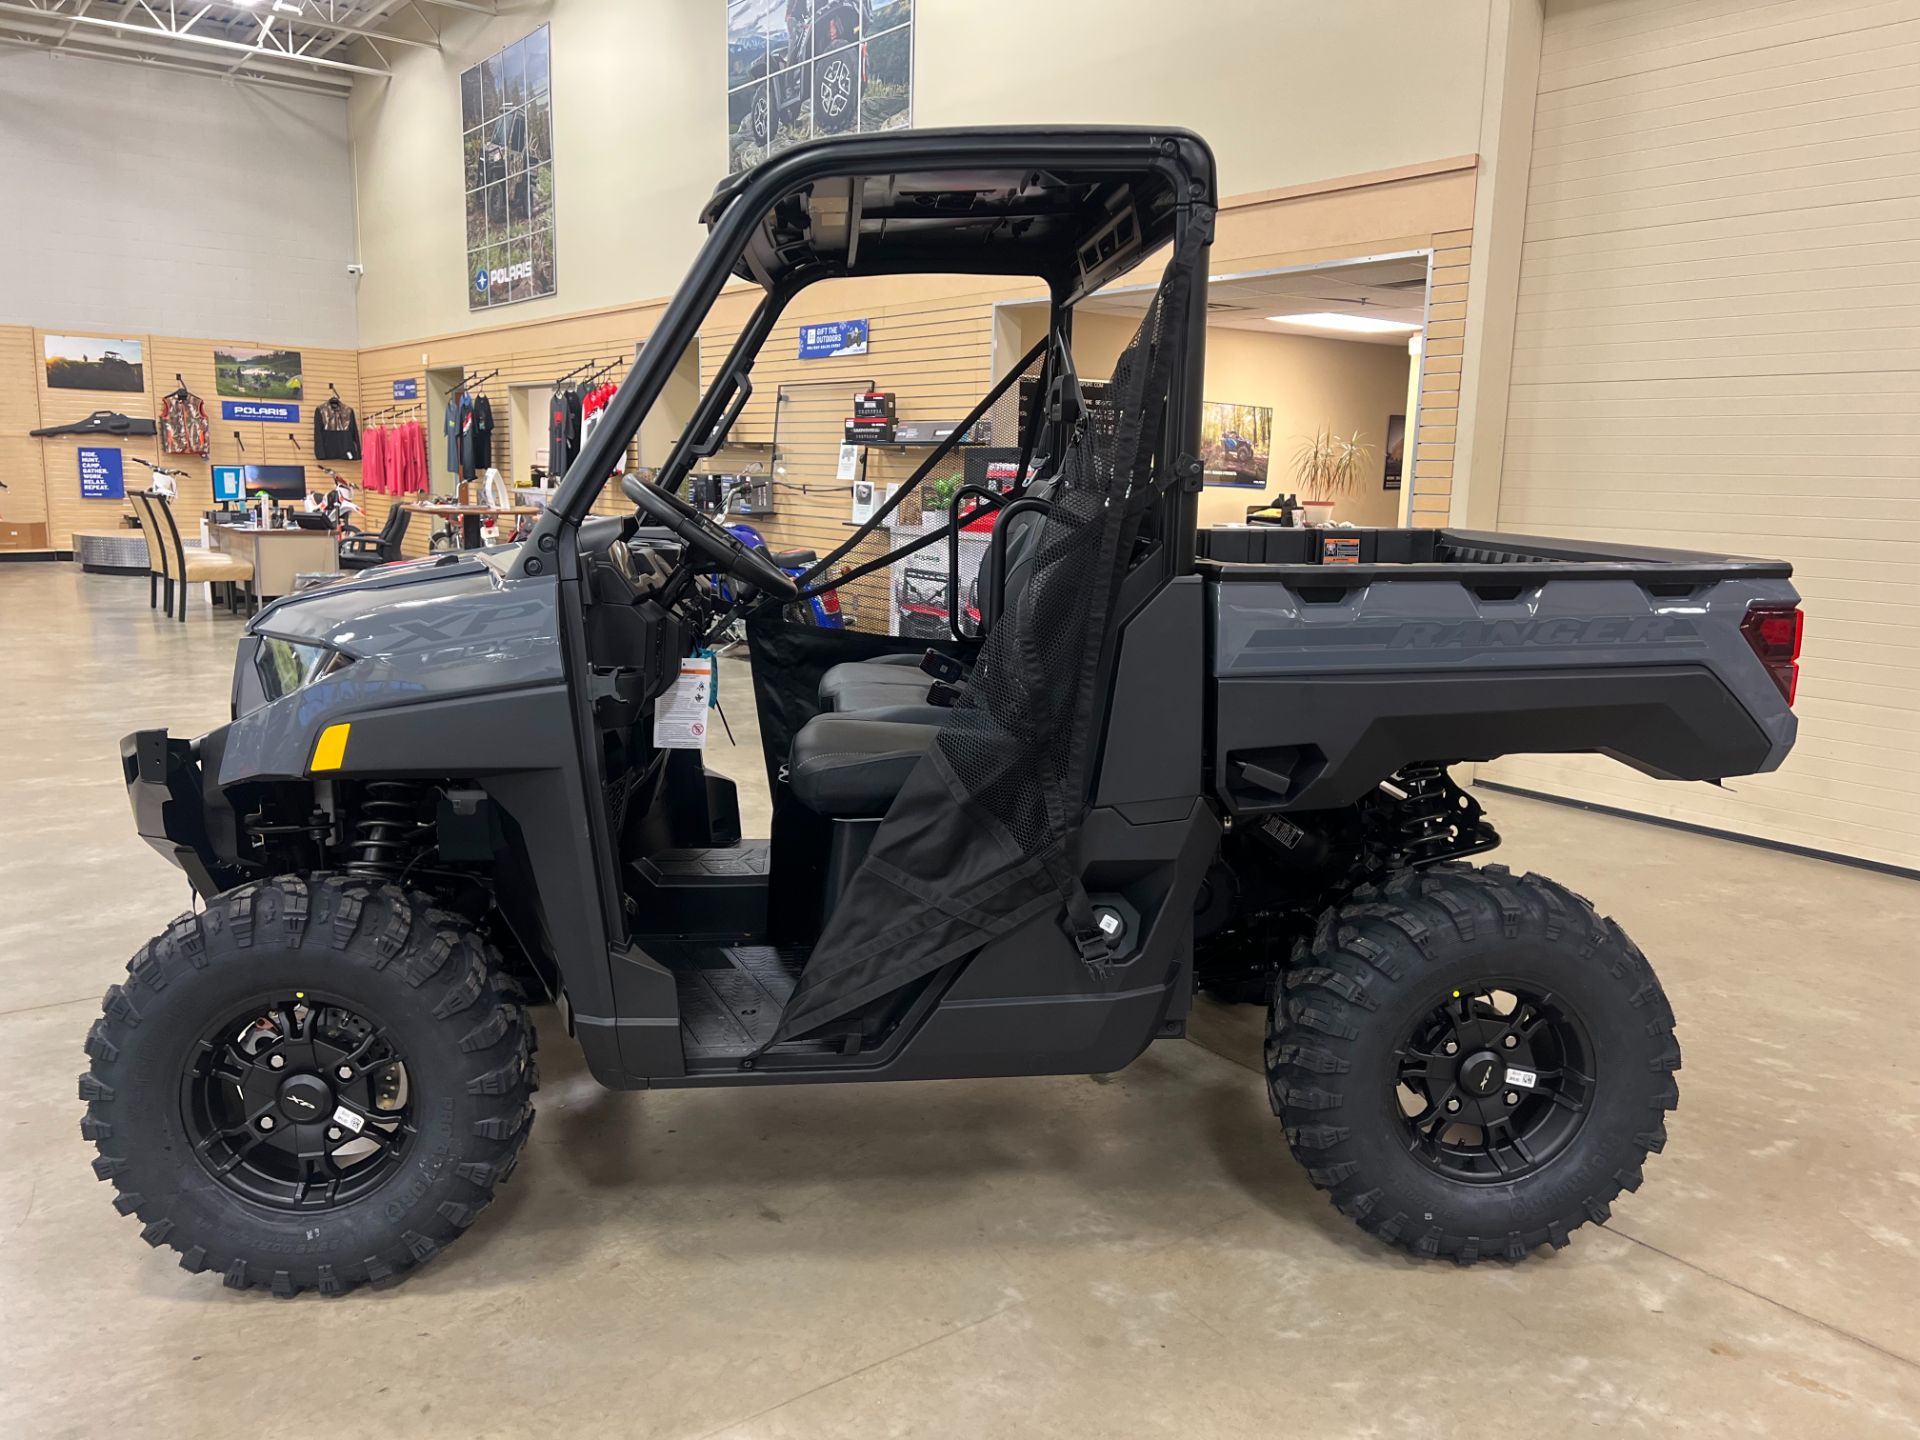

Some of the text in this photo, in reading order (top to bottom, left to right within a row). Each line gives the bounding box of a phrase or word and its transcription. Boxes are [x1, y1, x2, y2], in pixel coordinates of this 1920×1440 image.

[490, 260, 532, 286] POLARIS
[816, 334, 842, 344] OUTDOORS
[234, 406, 288, 416] POLARIS
[382, 602, 545, 650] XP
[1385, 616, 1675, 649] RANGER
